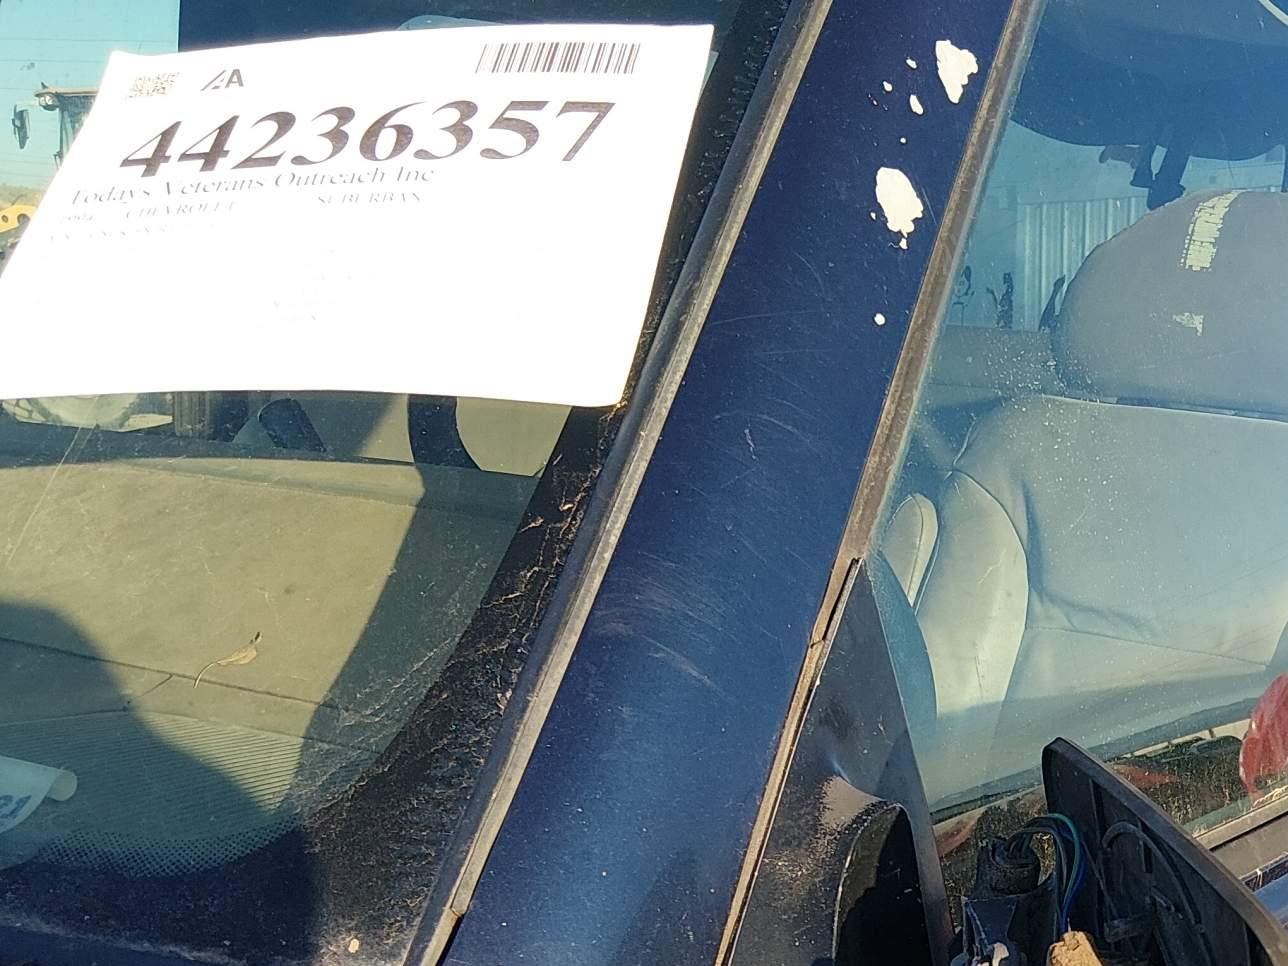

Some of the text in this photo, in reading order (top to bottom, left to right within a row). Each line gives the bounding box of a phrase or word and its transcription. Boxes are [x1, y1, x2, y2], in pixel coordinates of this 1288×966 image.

[119, 99, 617, 178] 44236357
[72, 166, 435, 205] Todays Veterans Outreach Inc
